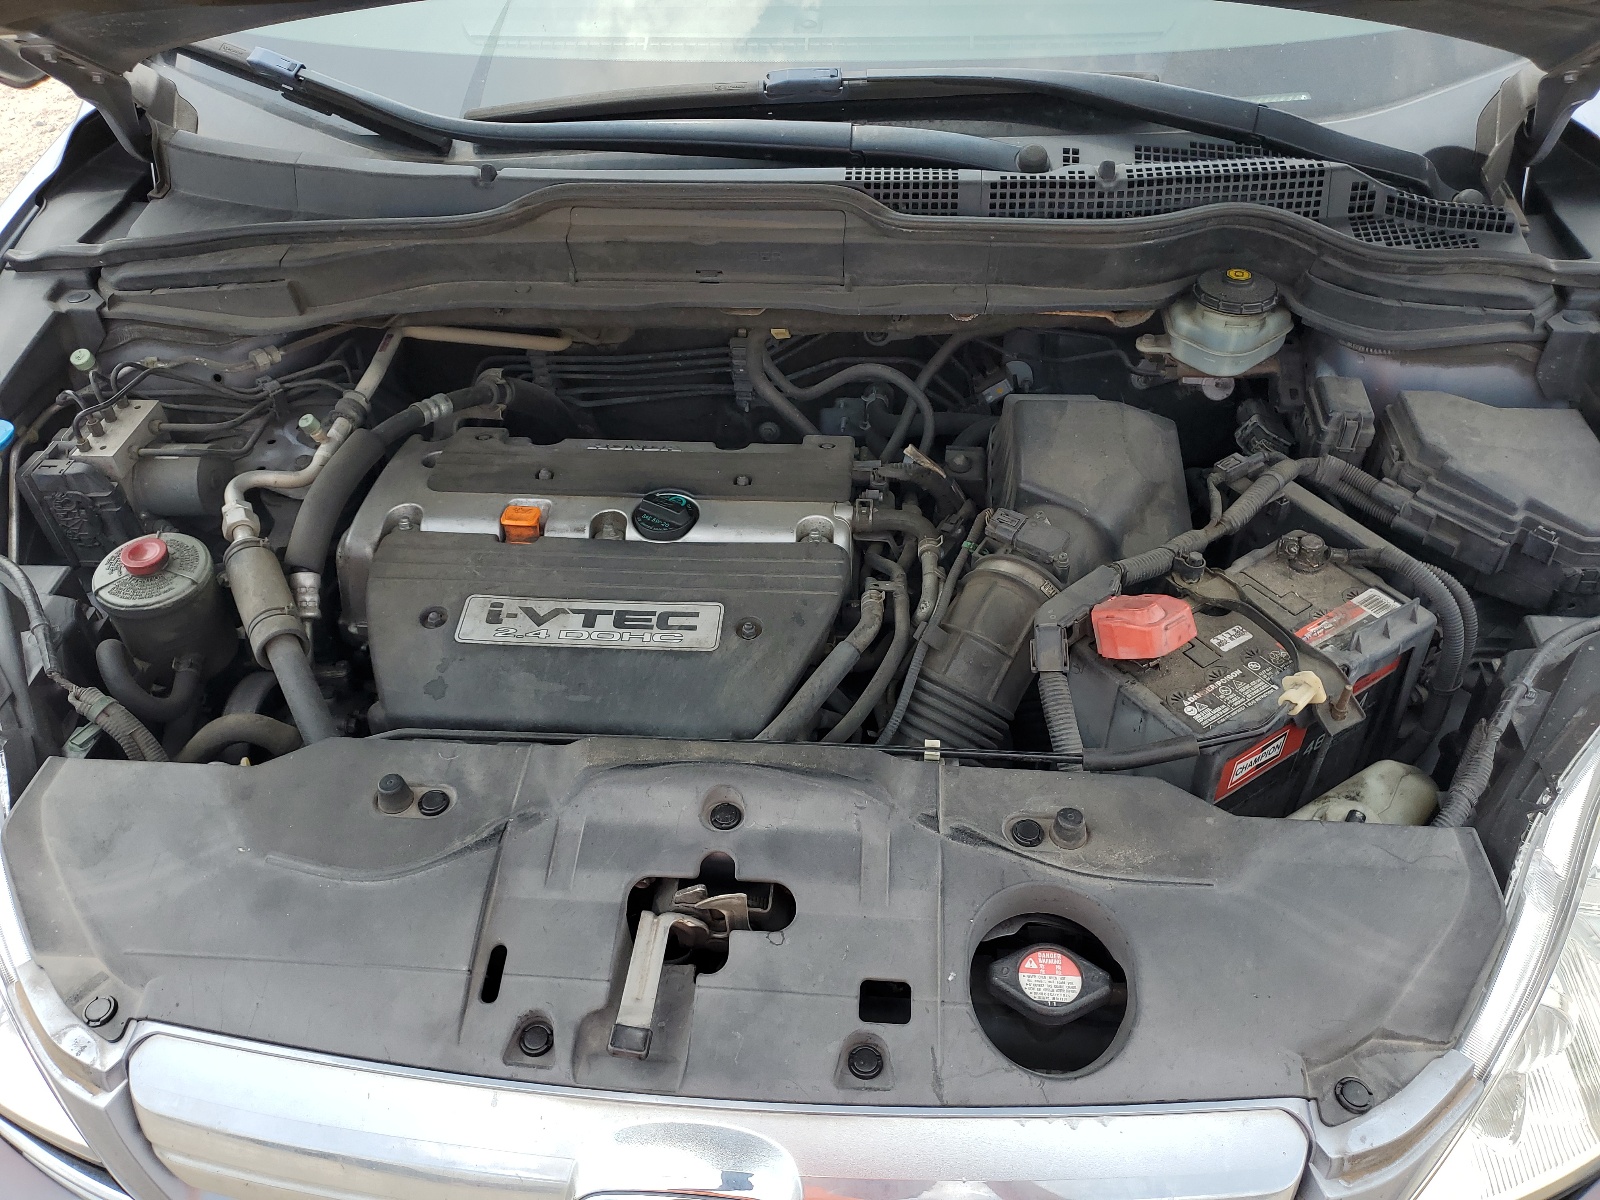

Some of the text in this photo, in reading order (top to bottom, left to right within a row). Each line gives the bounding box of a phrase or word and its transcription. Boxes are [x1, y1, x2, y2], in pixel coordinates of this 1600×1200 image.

[485, 601, 700, 631] i-VTEC
[493, 626, 684, 643] 2.4 DOHC
[1235, 740, 1284, 777] CHAMPION
[1038, 952, 1062, 960] DANGER
